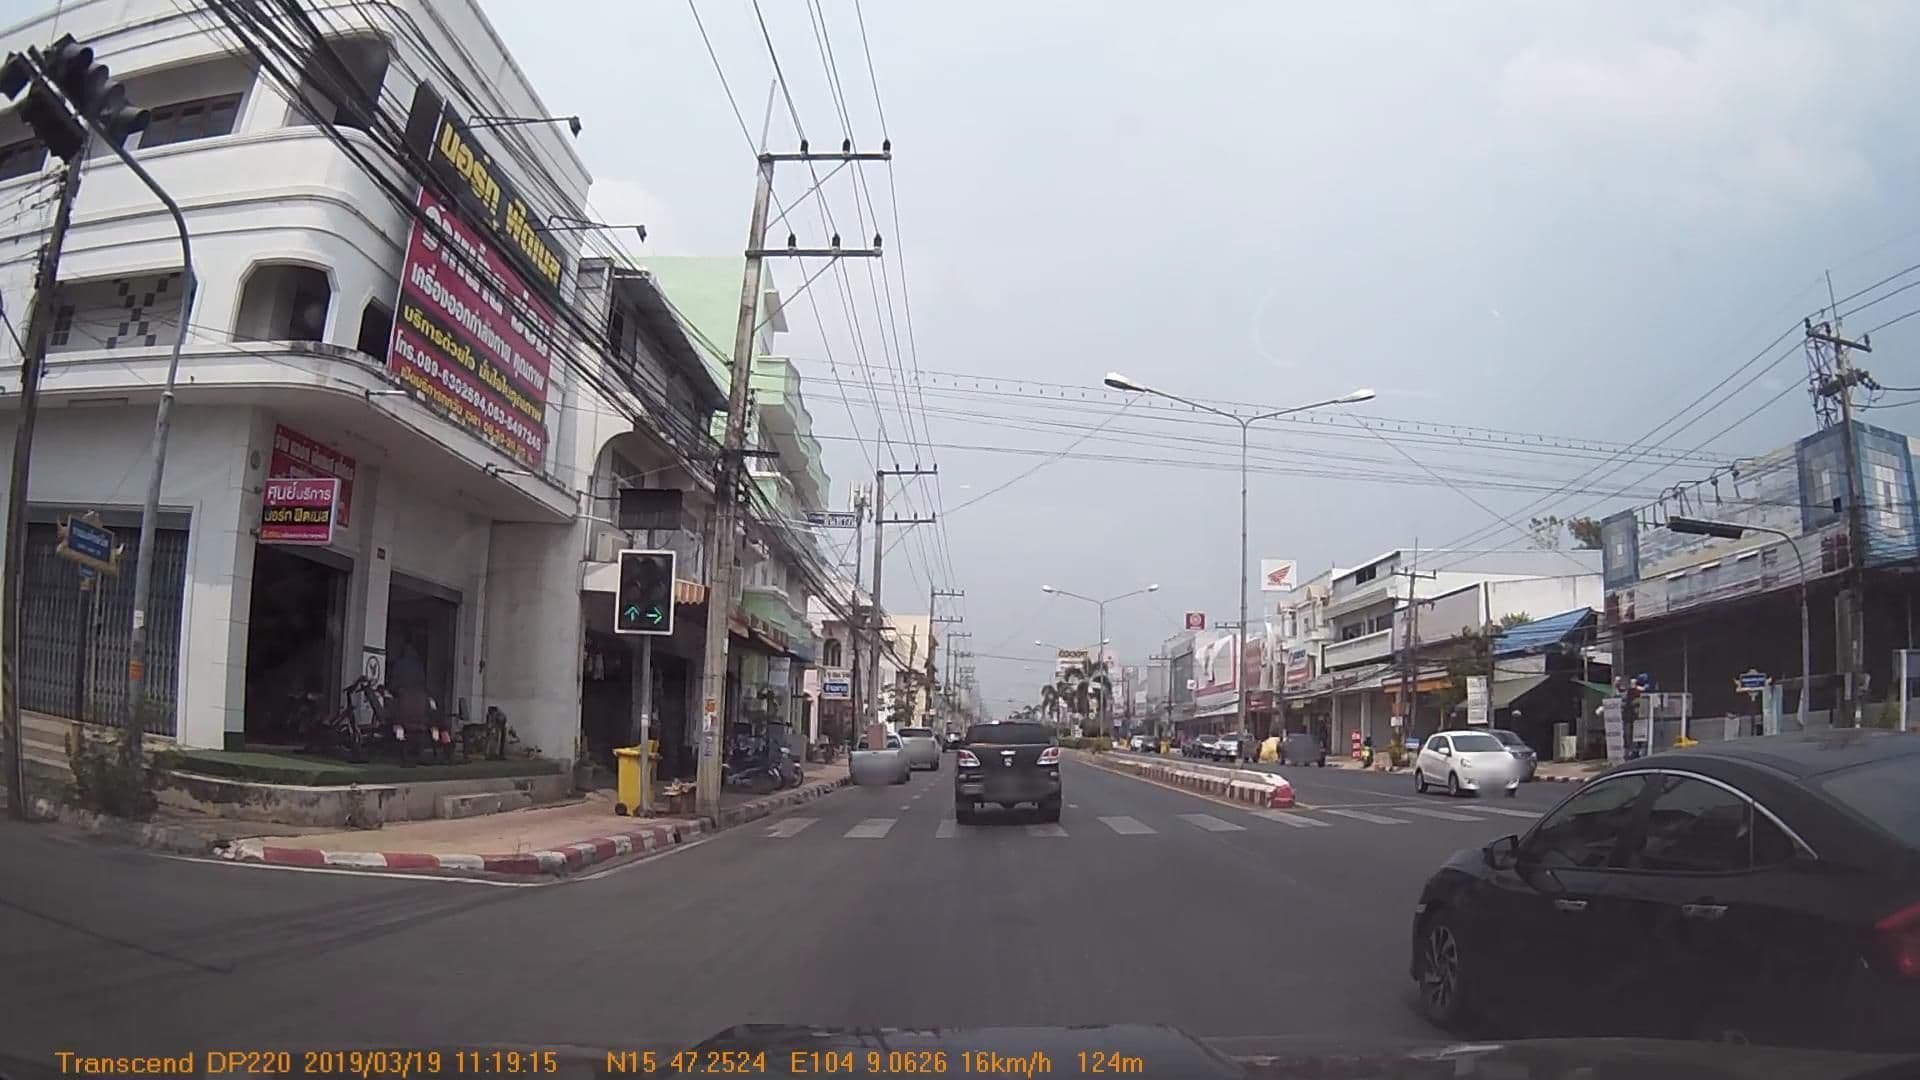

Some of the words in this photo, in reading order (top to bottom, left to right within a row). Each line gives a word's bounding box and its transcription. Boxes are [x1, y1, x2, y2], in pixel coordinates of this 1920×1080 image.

[404, 305, 475, 370] บริการด้วยใจ
[411, 263, 511, 364] เครื่องออกกำลังกาย
[513, 352, 545, 391] คุณภาพ
[267, 482, 332, 505] ศูนย์บริการ
